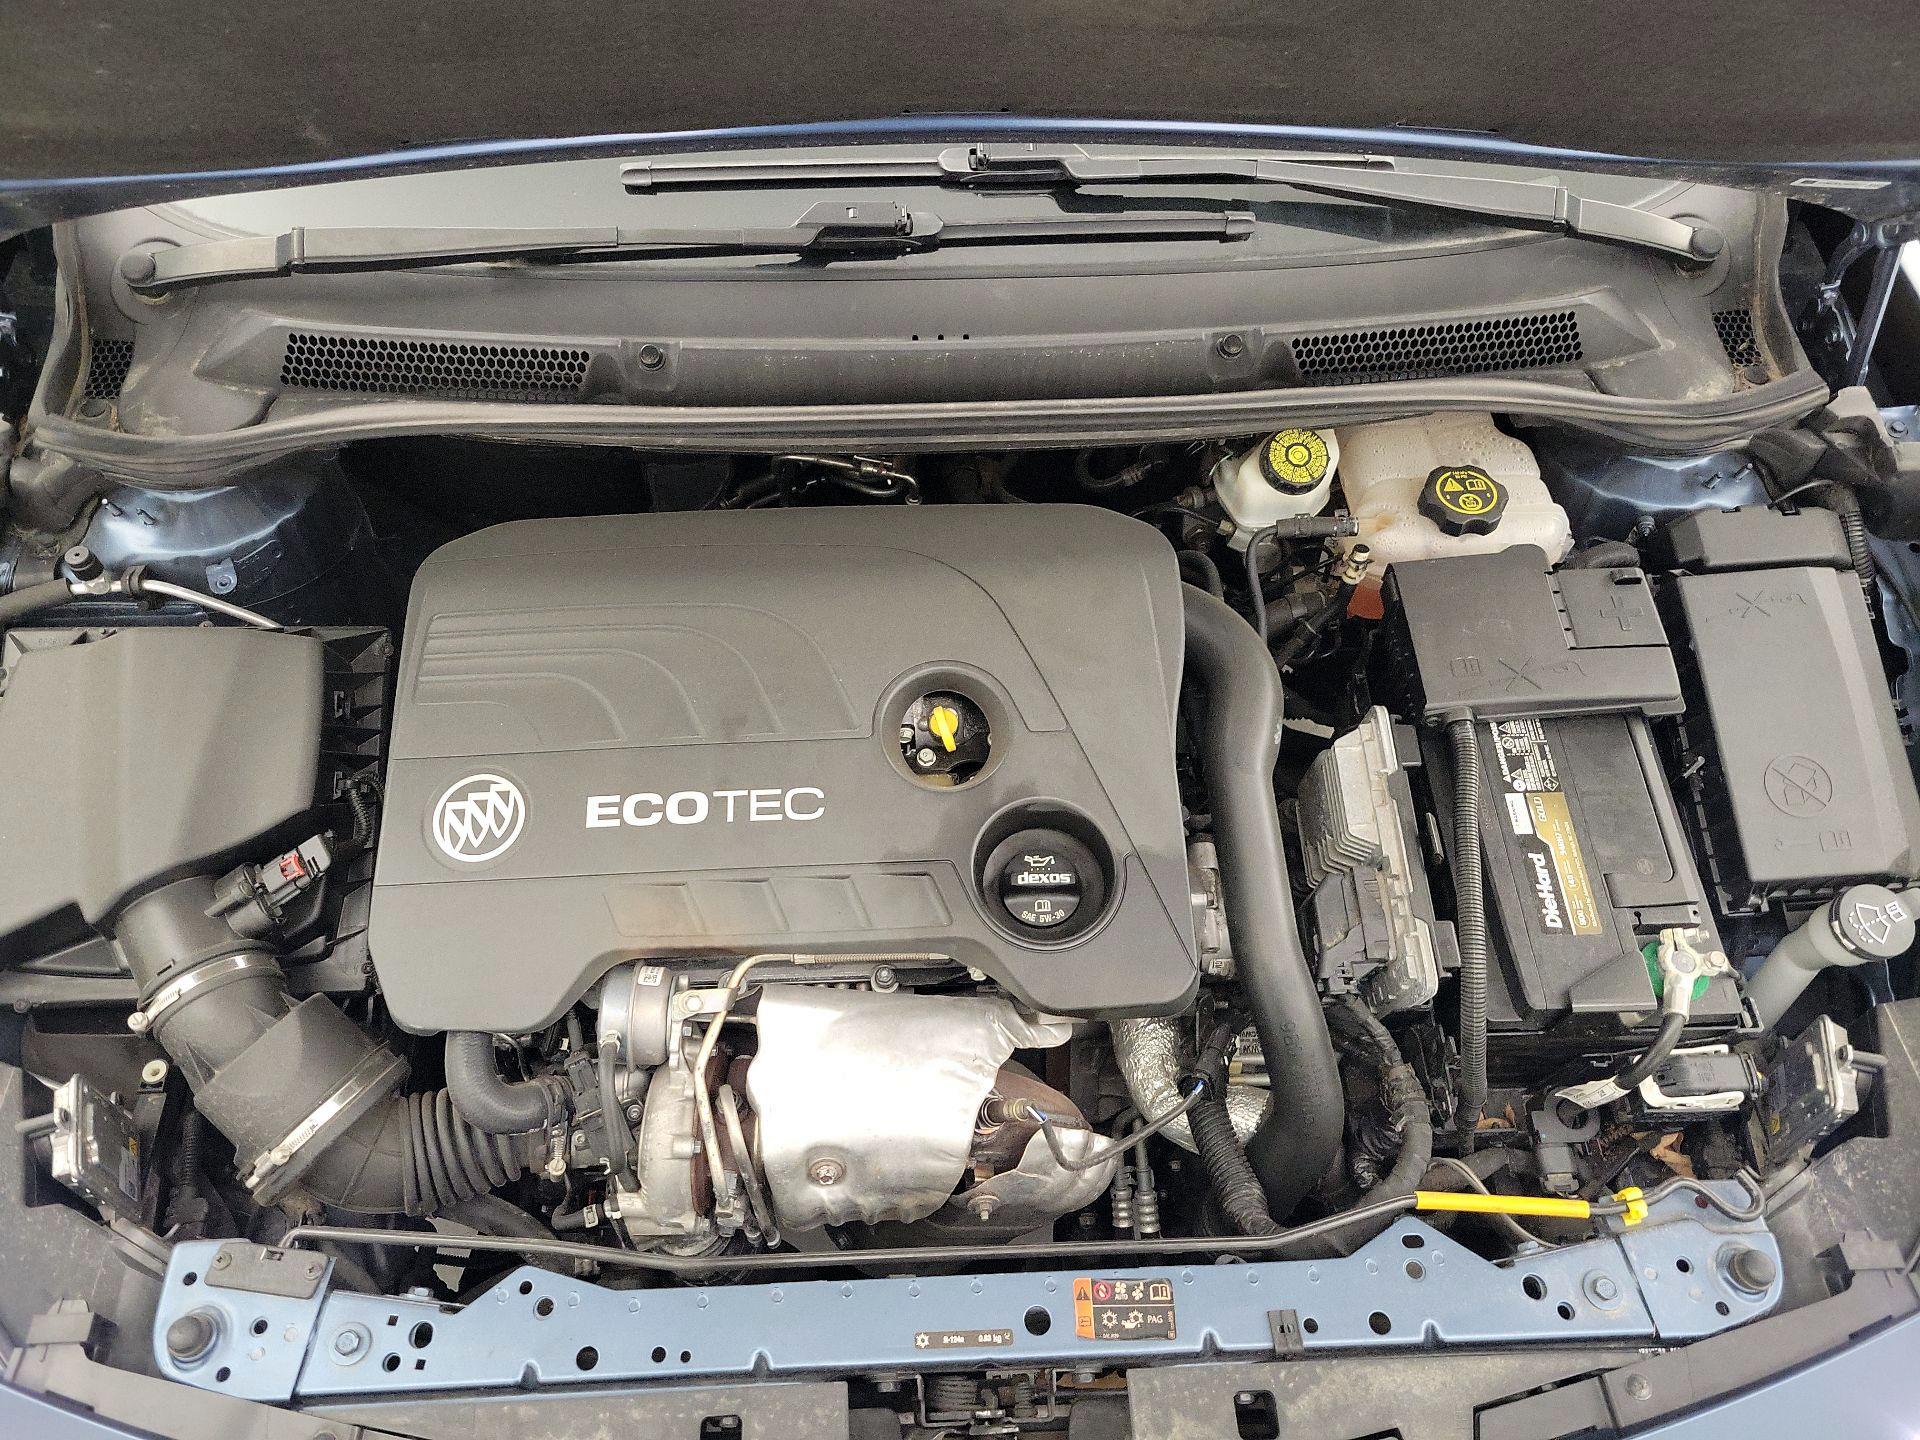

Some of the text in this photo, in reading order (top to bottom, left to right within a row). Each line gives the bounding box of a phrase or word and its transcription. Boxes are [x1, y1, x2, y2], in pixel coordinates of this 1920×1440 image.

[585, 787, 825, 828] ECOTEC
[1018, 872, 1071, 885] dexos
[1528, 852, 1563, 929] DieHard
[1021, 909, 1065, 923] SAE 5W-30
[1147, 1315, 1163, 1324] PAG
